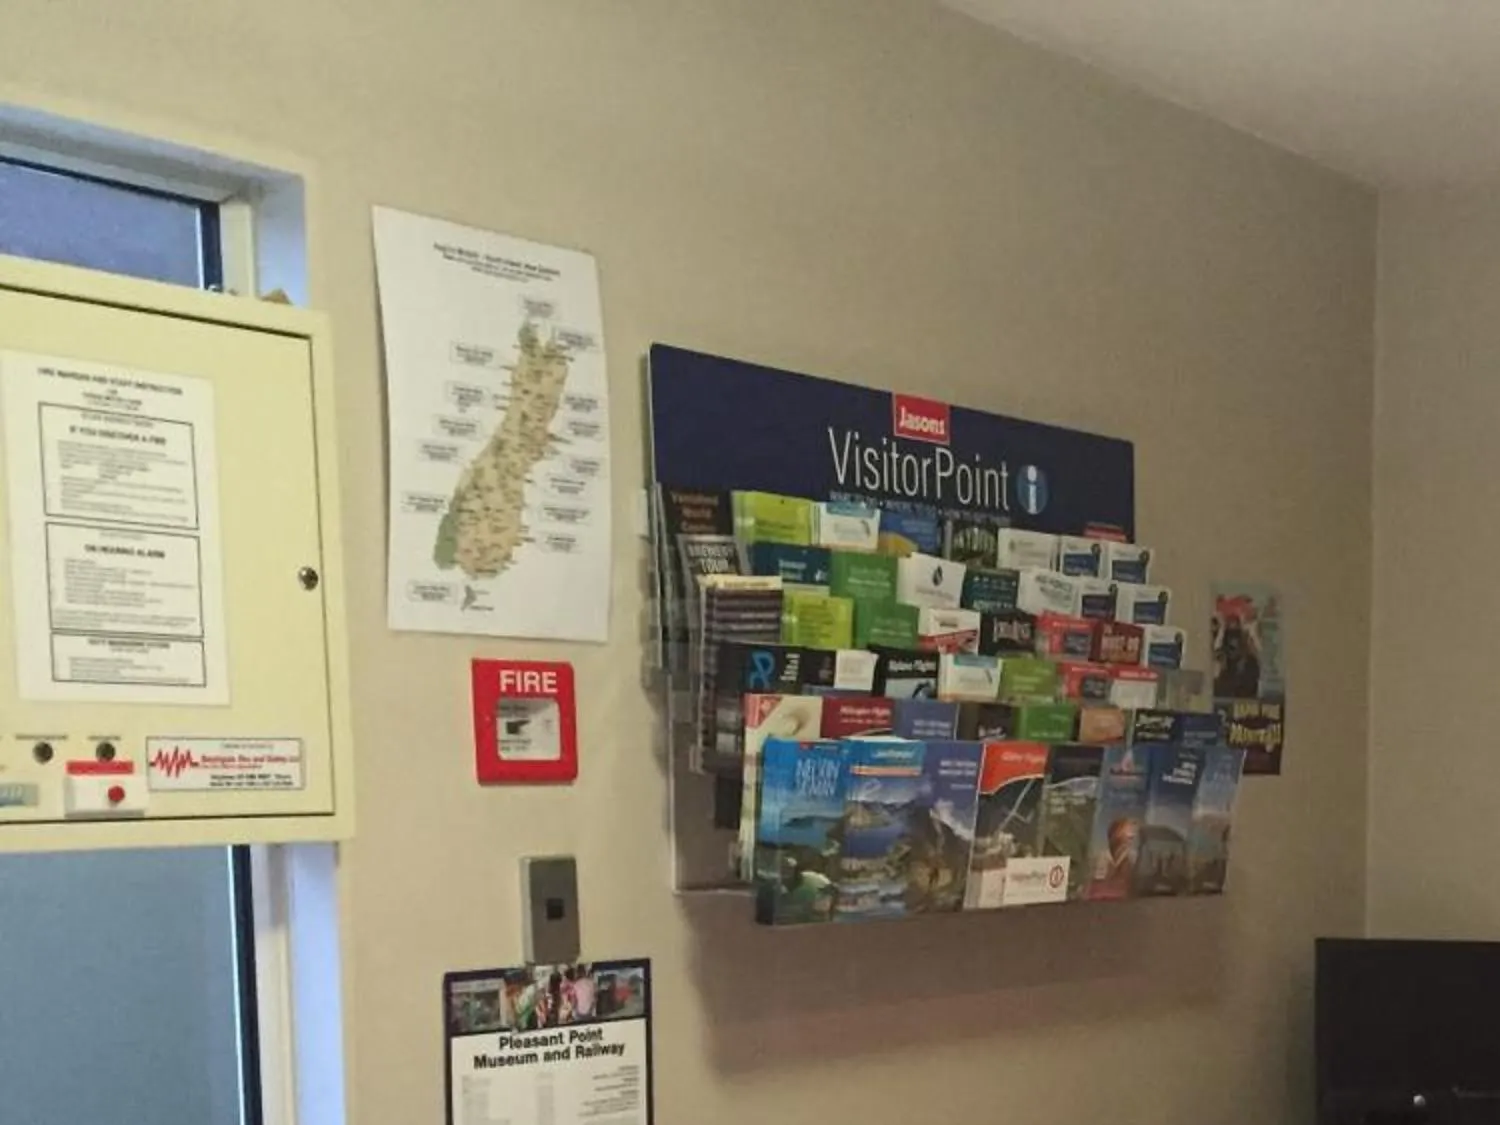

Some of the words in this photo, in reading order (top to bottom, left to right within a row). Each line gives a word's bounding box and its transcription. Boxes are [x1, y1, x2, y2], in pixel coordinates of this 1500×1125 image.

[900, 406, 945, 435] Jasons
[828, 426, 1009, 511] VisitorPoint
[499, 669, 558, 694] FIRE
[499, 1032, 565, 1051] Pleasant
[569, 1028, 604, 1044] Point
[474, 1051, 538, 1070] Museum
[543, 1047, 571, 1063] and
[575, 1042, 625, 1060] Railway
